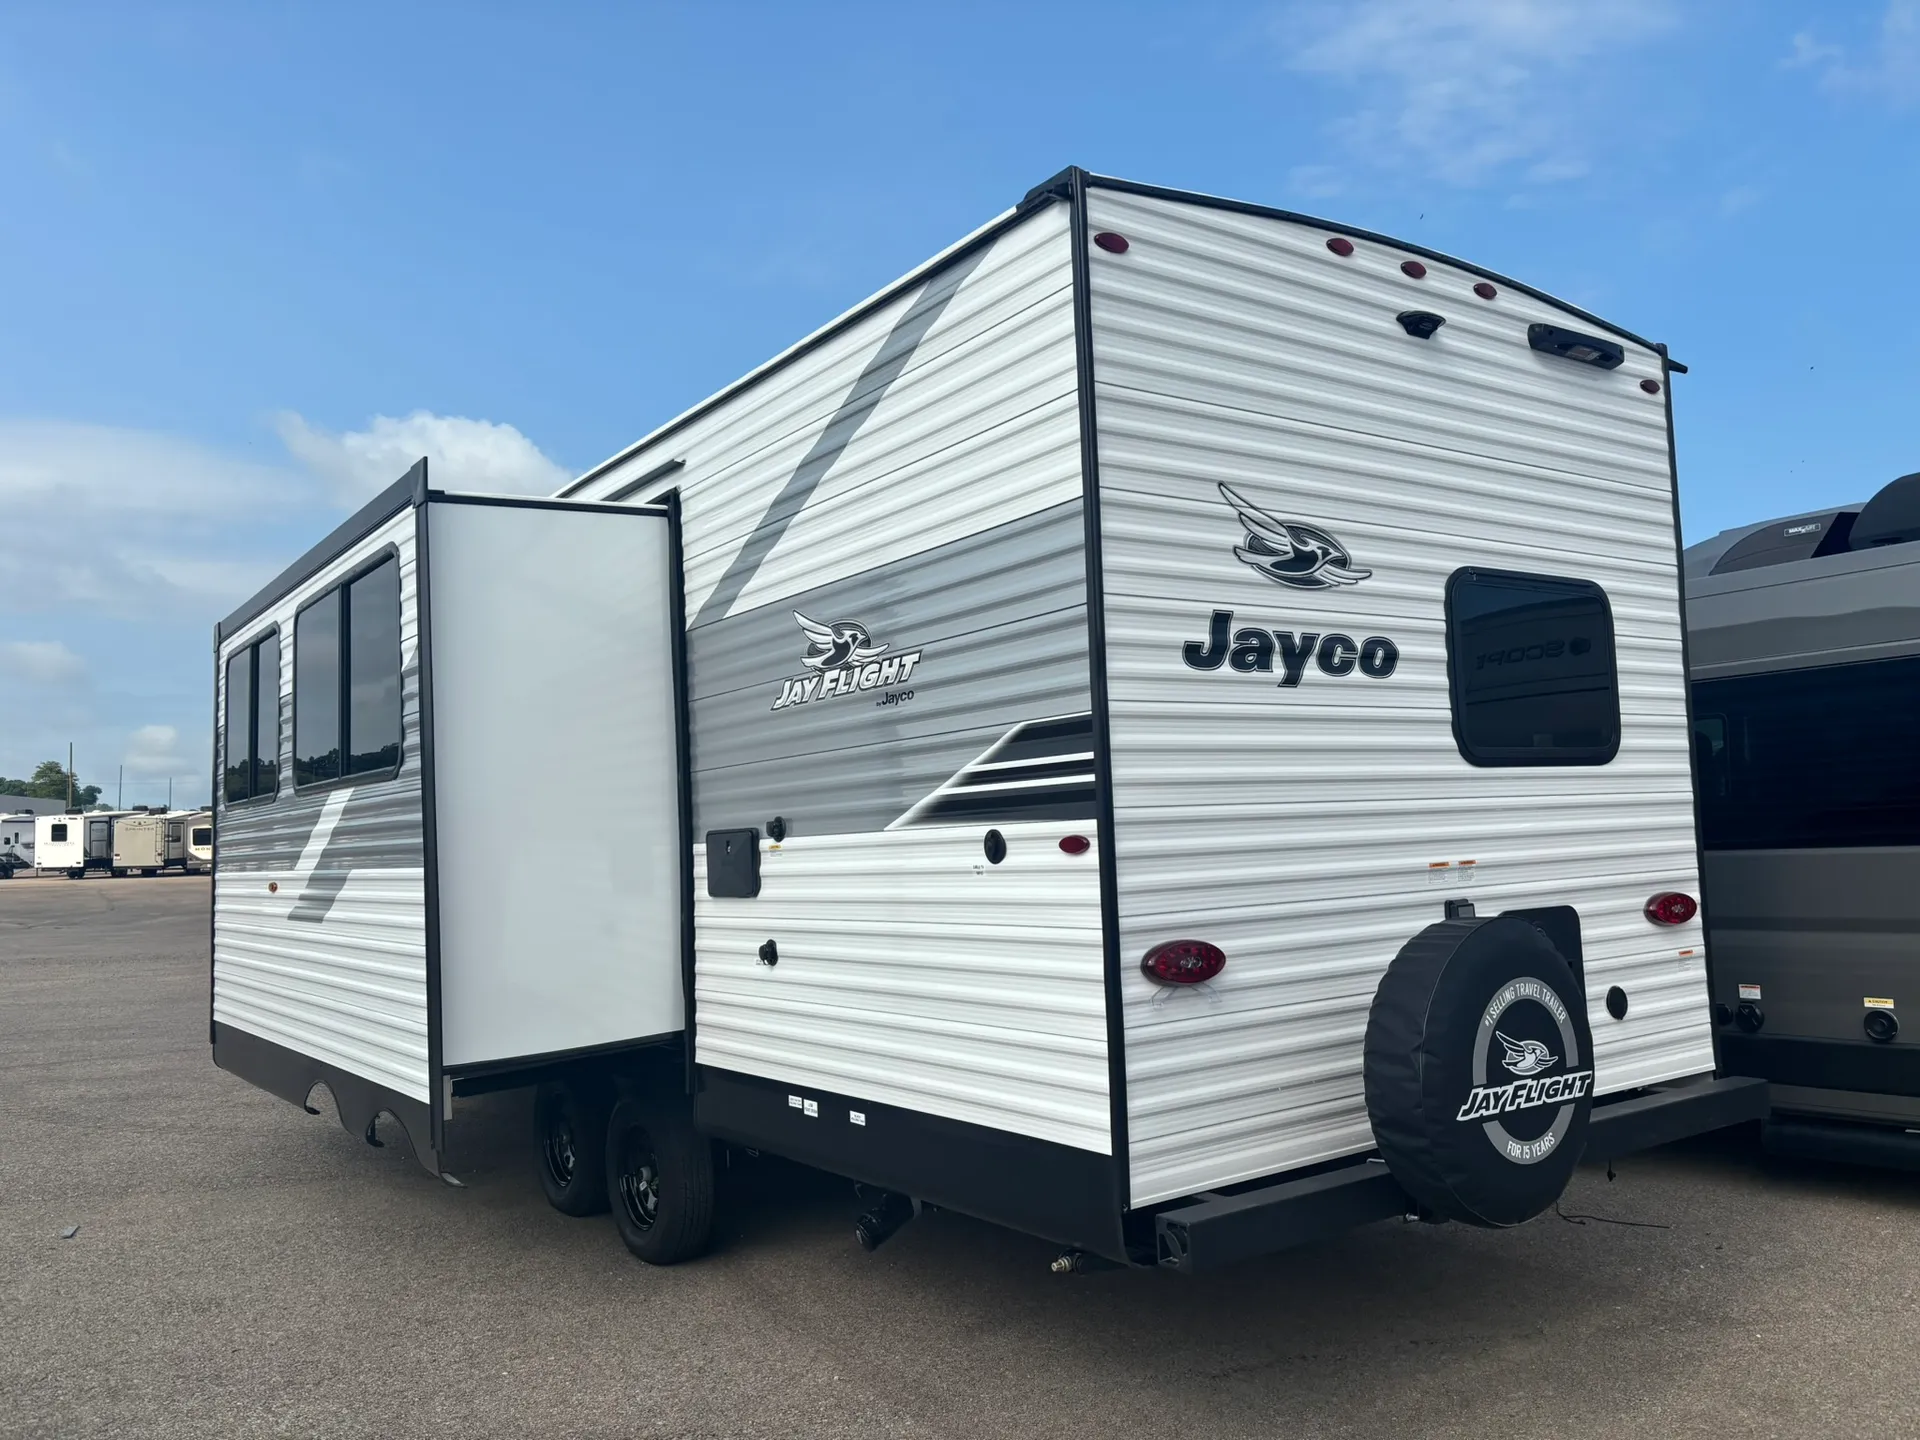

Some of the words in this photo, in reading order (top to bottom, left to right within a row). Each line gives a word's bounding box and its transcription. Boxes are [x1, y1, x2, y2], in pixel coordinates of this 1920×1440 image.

[1182, 609, 1400, 688] Jayco
[771, 676, 818, 711] JAY
[817, 649, 924, 701] FLIGHT
[882, 690, 915, 706] Jayco
[1484, 1015, 1494, 1027] #1
[1489, 986, 1515, 1019] SELLING
[1515, 982, 1541, 998] TRAVEL
[1542, 988, 1567, 1024] TRAILER
[1456, 1087, 1508, 1121] JAY
[1505, 1071, 1593, 1112] FLIGHT
[1507, 1140, 1521, 1158] FOR
[1522, 1145, 1530, 1159] 15
[1531, 1132, 1555, 1157] YEARS
